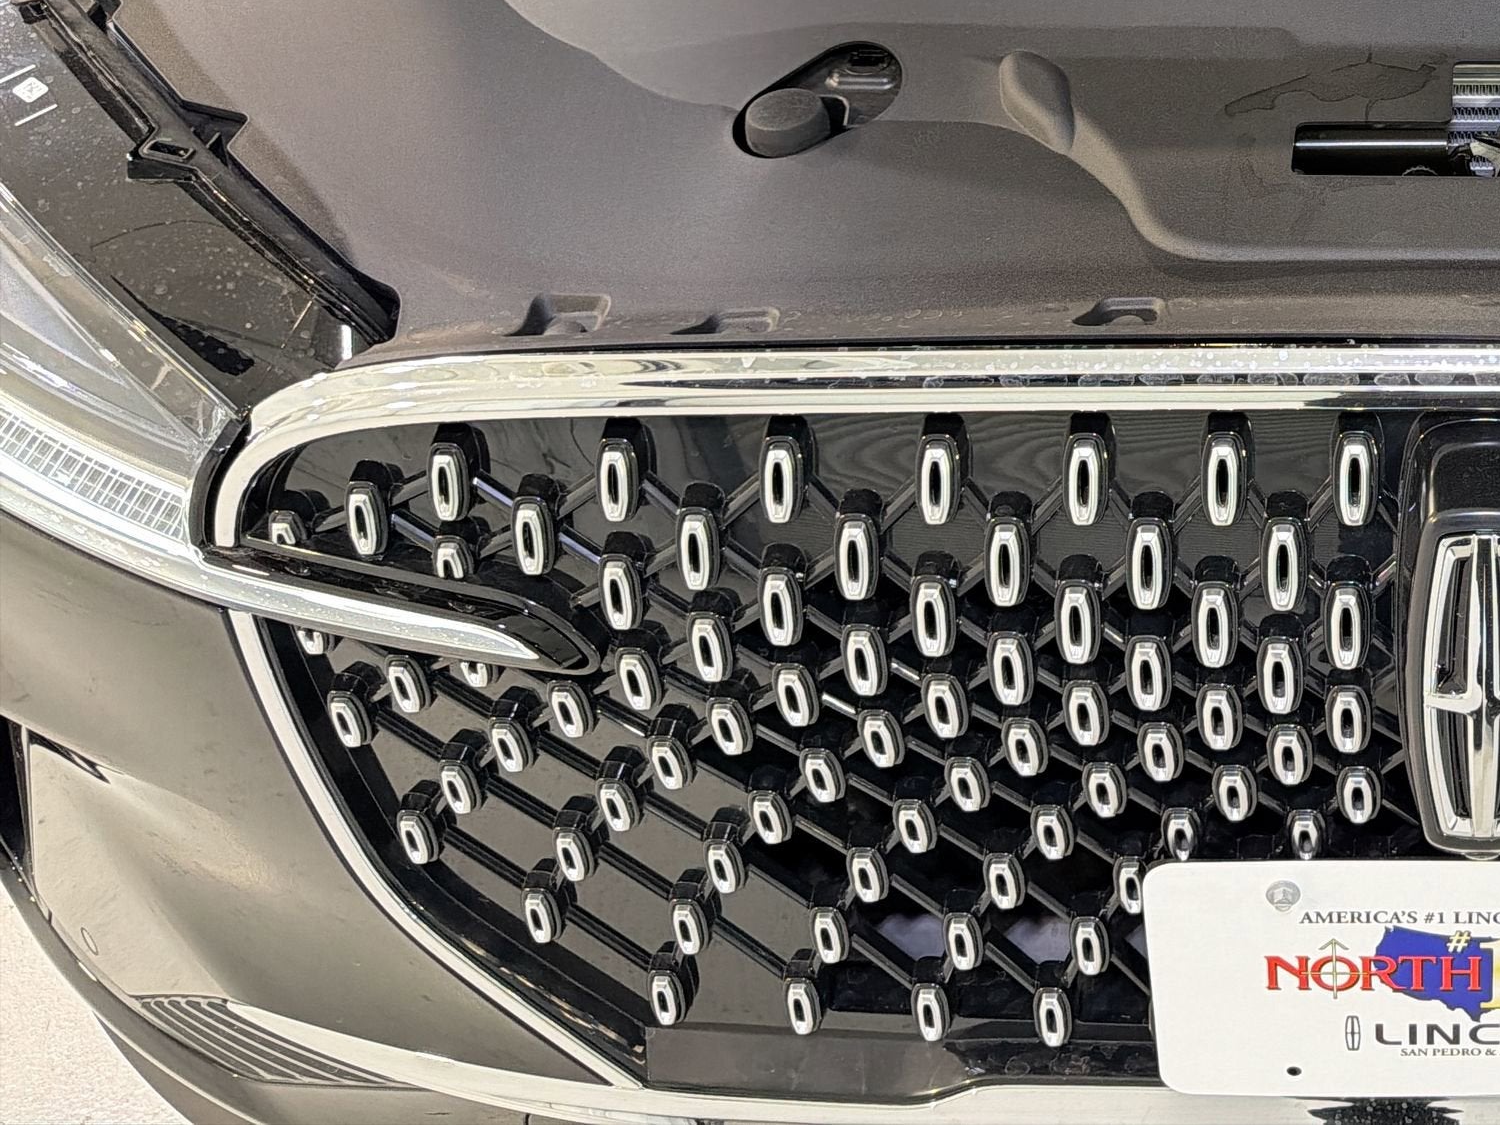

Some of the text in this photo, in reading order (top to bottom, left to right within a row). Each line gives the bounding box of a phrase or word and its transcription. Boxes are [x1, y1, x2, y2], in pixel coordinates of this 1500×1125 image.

[1298, 910, 1418, 925] AMERICA'S
[1423, 910, 1448, 925] #1
[1264, 954, 1481, 993] NORTH
[1400, 1048, 1430, 1056] SAN
[1434, 1048, 1482, 1056] PEDRO
[1485, 1048, 1496, 1056] &
